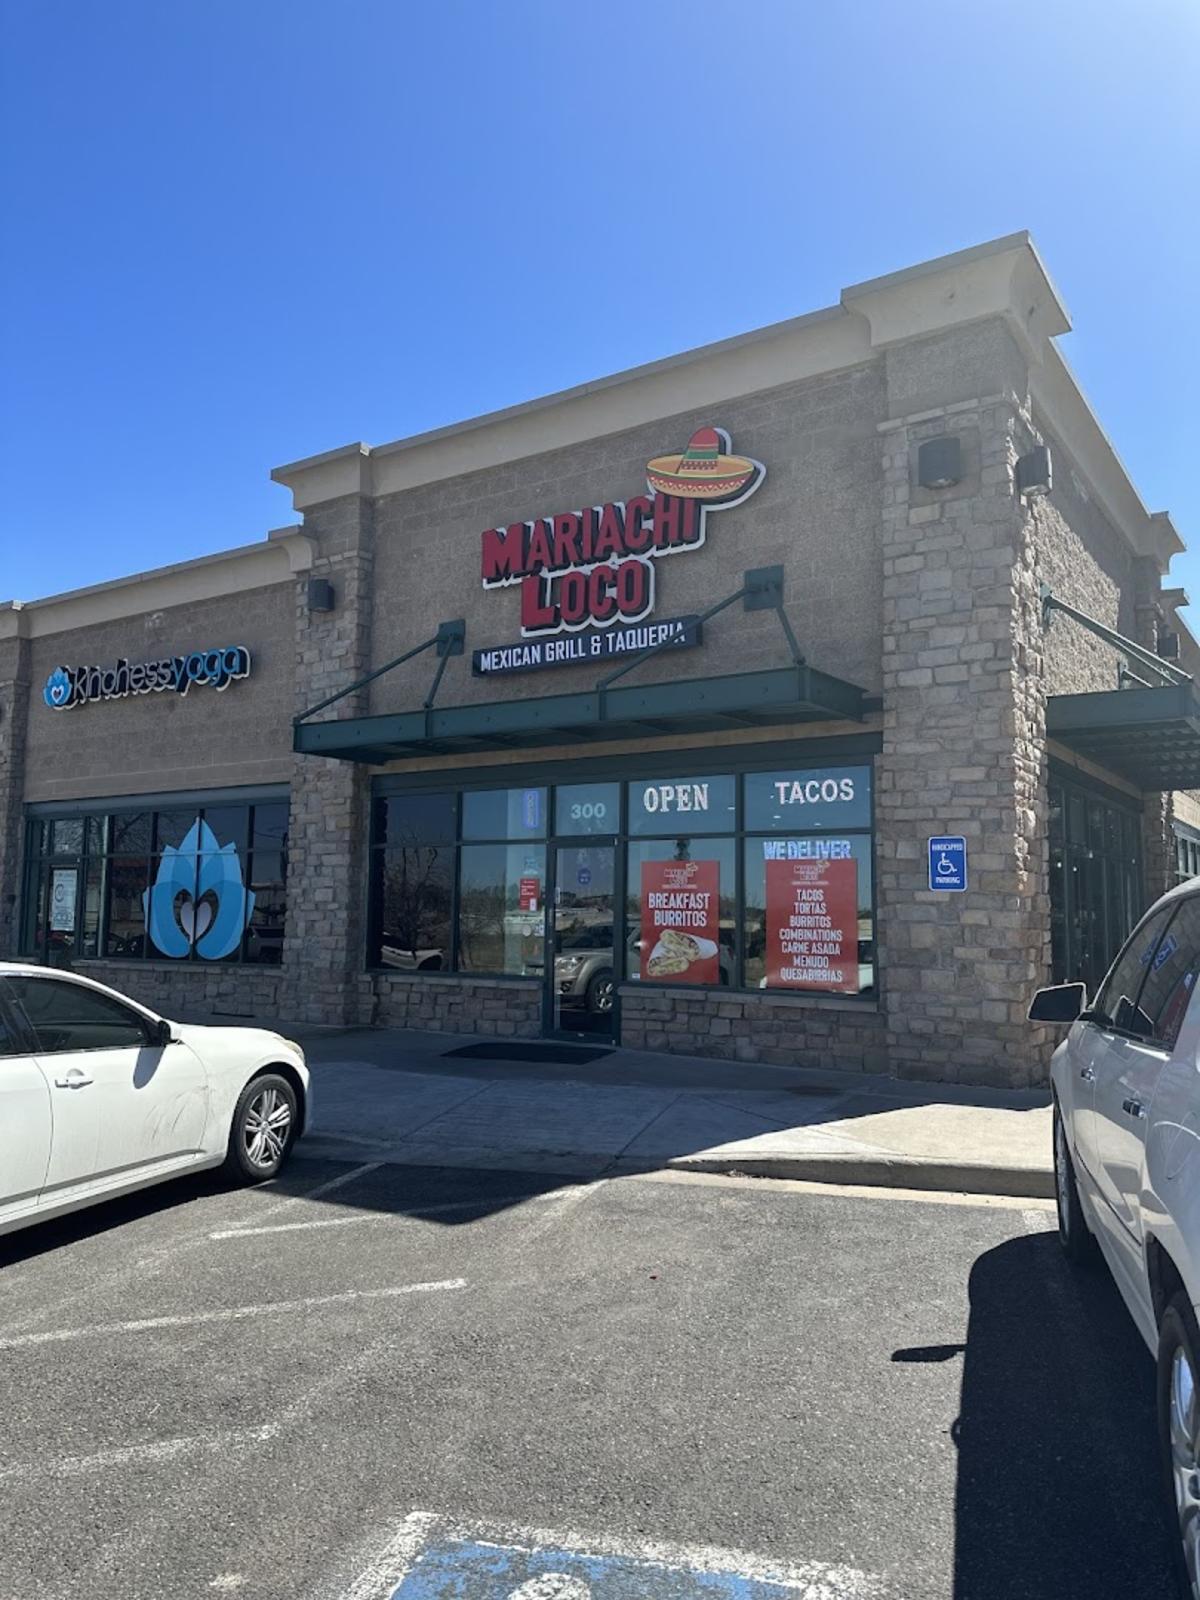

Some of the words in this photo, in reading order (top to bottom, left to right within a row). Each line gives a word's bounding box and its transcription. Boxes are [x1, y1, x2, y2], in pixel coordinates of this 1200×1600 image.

[481, 494, 697, 579] MARIACHI
[521, 559, 645, 627] LOCO
[480, 644, 542, 672] MEXICAN
[545, 638, 586, 662] GRILL
[591, 635, 601, 654] &
[643, 783, 709, 813] OPEN
[774, 778, 855, 805] TACOS
[571, 802, 606, 820] 300
[763, 841, 786, 860] WE
[787, 839, 852, 860] DELIVER
[648, 892, 711, 910] BREAKFAST
[796, 888, 825, 902] TACOS
[793, 901, 827, 915] TORTAS
[654, 909, 707, 927] BURRITOS
[789, 915, 832, 928] BURRITOS
[778, 928, 843, 942] COMBINATIONS
[781, 941, 809, 954] CARNE
[811, 942, 841, 955] ASADA
[793, 955, 829, 968] MENUDO
[780, 967, 843, 982] QUESABIRRIAS
